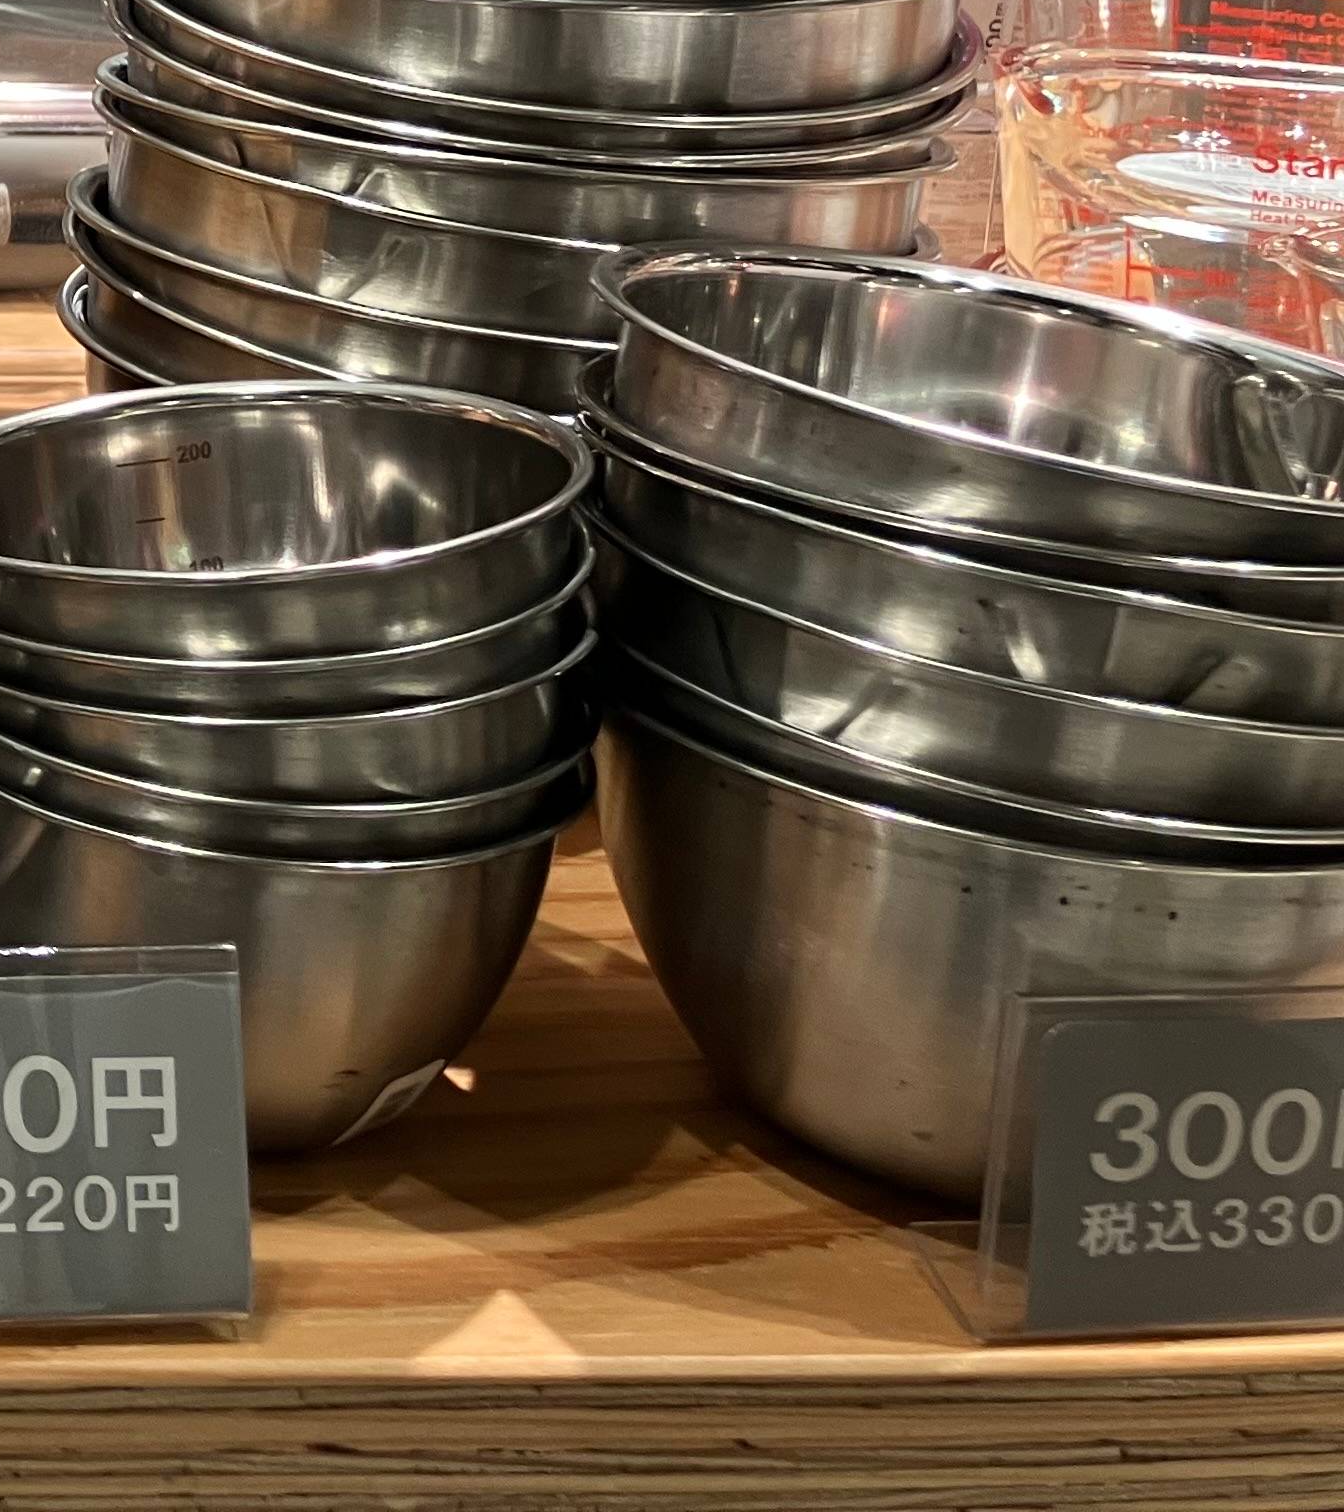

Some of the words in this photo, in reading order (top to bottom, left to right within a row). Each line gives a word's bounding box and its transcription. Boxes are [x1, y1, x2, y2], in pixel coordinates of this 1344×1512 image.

[176, 441, 211, 464] 200
[1089, 1088, 1344, 1182] 300
[1078, 1194, 1344, 1258] 税込330
